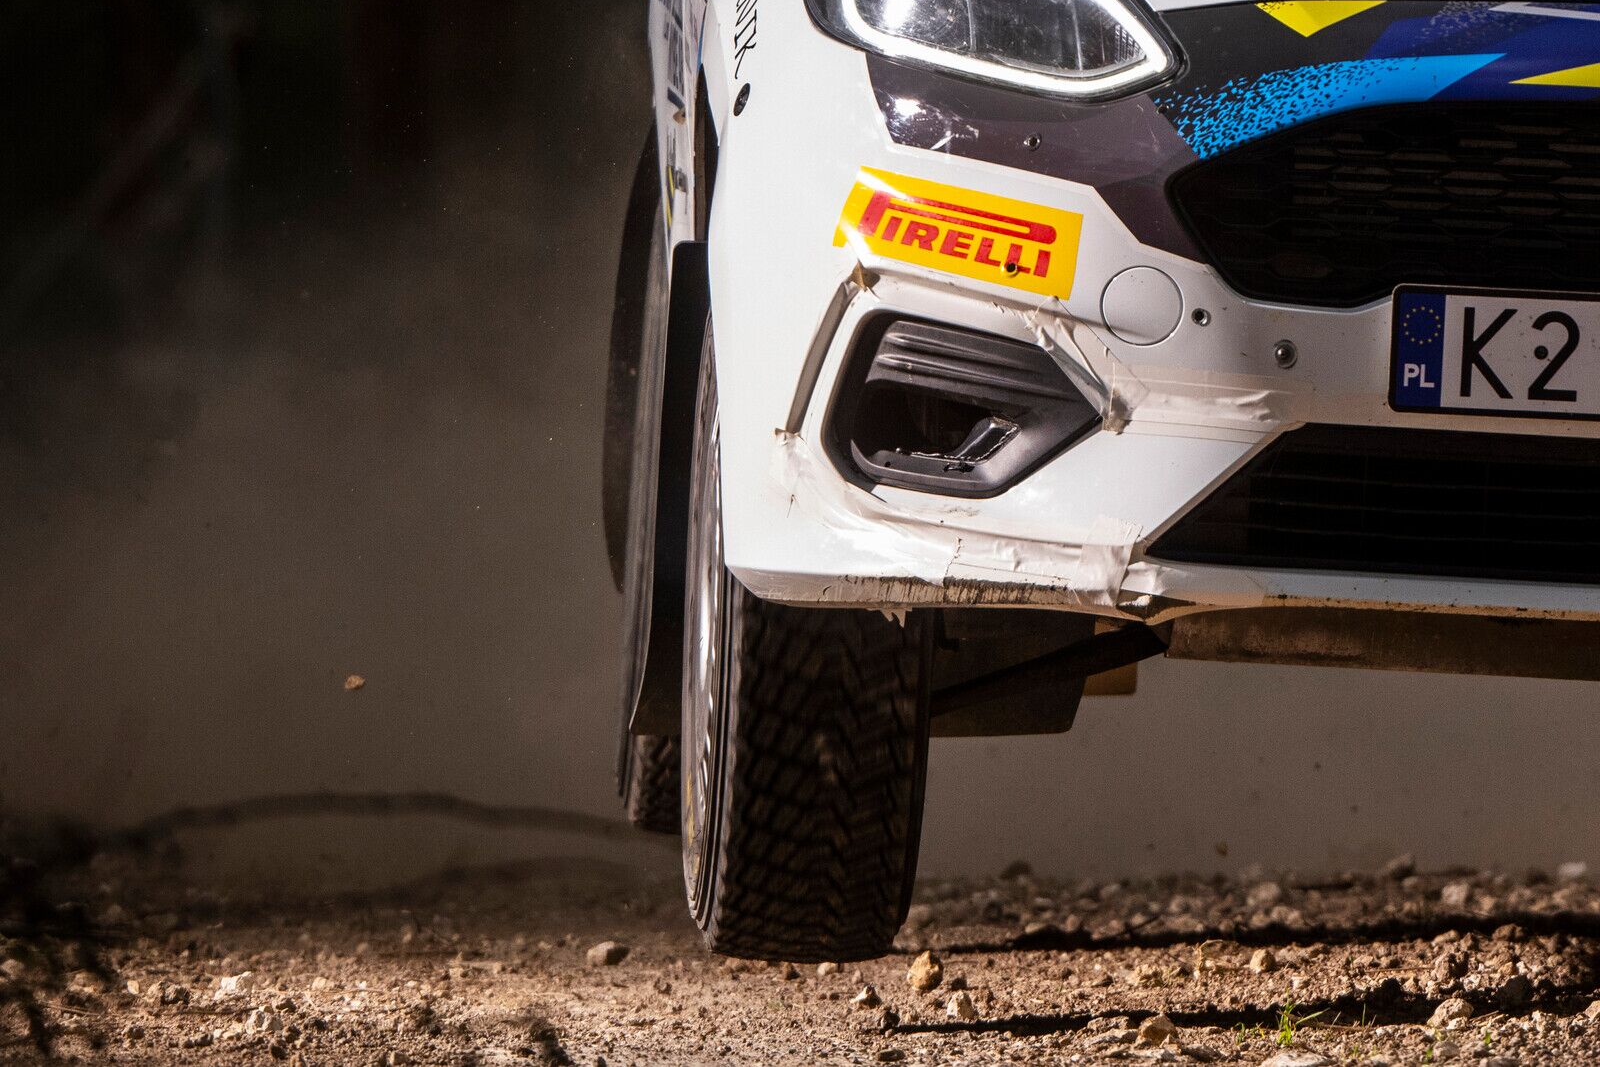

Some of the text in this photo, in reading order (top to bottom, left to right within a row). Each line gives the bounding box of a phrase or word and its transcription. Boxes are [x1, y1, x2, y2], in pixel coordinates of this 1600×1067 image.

[857, 190, 1056, 278] PIRELLI
[1402, 363, 1435, 389] PL
[1459, 307, 1580, 402] K2
